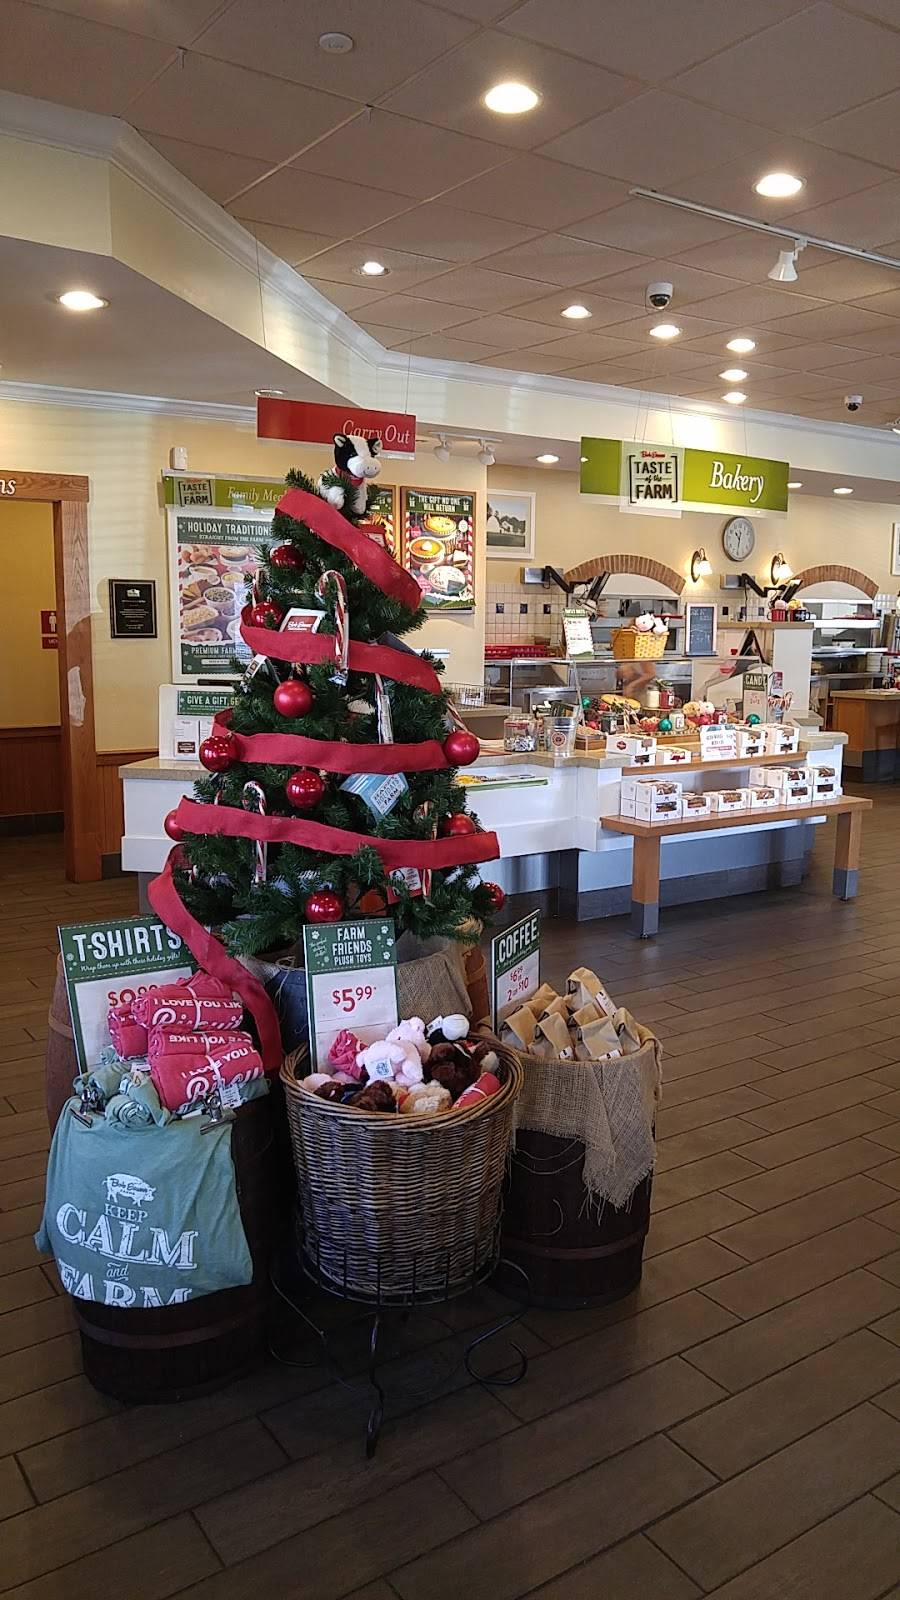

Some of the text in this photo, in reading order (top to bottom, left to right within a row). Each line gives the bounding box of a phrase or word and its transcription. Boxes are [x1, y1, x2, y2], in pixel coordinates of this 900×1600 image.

[385, 425, 410, 444] Out
[634, 462, 672, 474] TASTE
[645, 475, 652, 484] of
[710, 461, 764, 503] Bakery
[182, 483, 208, 492] TASTE
[228, 486, 260, 504] Family
[636, 484, 672, 499] FARM
[184, 496, 209, 505] FARM
[188, 522, 222, 533] HOLIDAY
[192, 646, 218, 654] PREMIUM
[187, 696, 202, 704] GIVE
[205, 696, 210, 704] A
[230, 697, 239, 706] GE
[337, 926, 365, 941] FARM
[499, 918, 537, 962] COFFEE
[72, 924, 182, 962] T-SHIRTS
[332, 940, 372, 956] FRIENDS
[80, 965, 96, 973] Wrap
[147, 954, 165, 962] holiday
[334, 953, 372, 966] PLUSH TOYS
[169, 1035, 198, 1043] LIKE
[222, 1047, 248, 1062] YOU
[110, 1178, 126, 1188] Bob
[105, 1203, 148, 1223] KEEP
[56, 1202, 198, 1270] CALM
[106, 1263, 129, 1280] and
